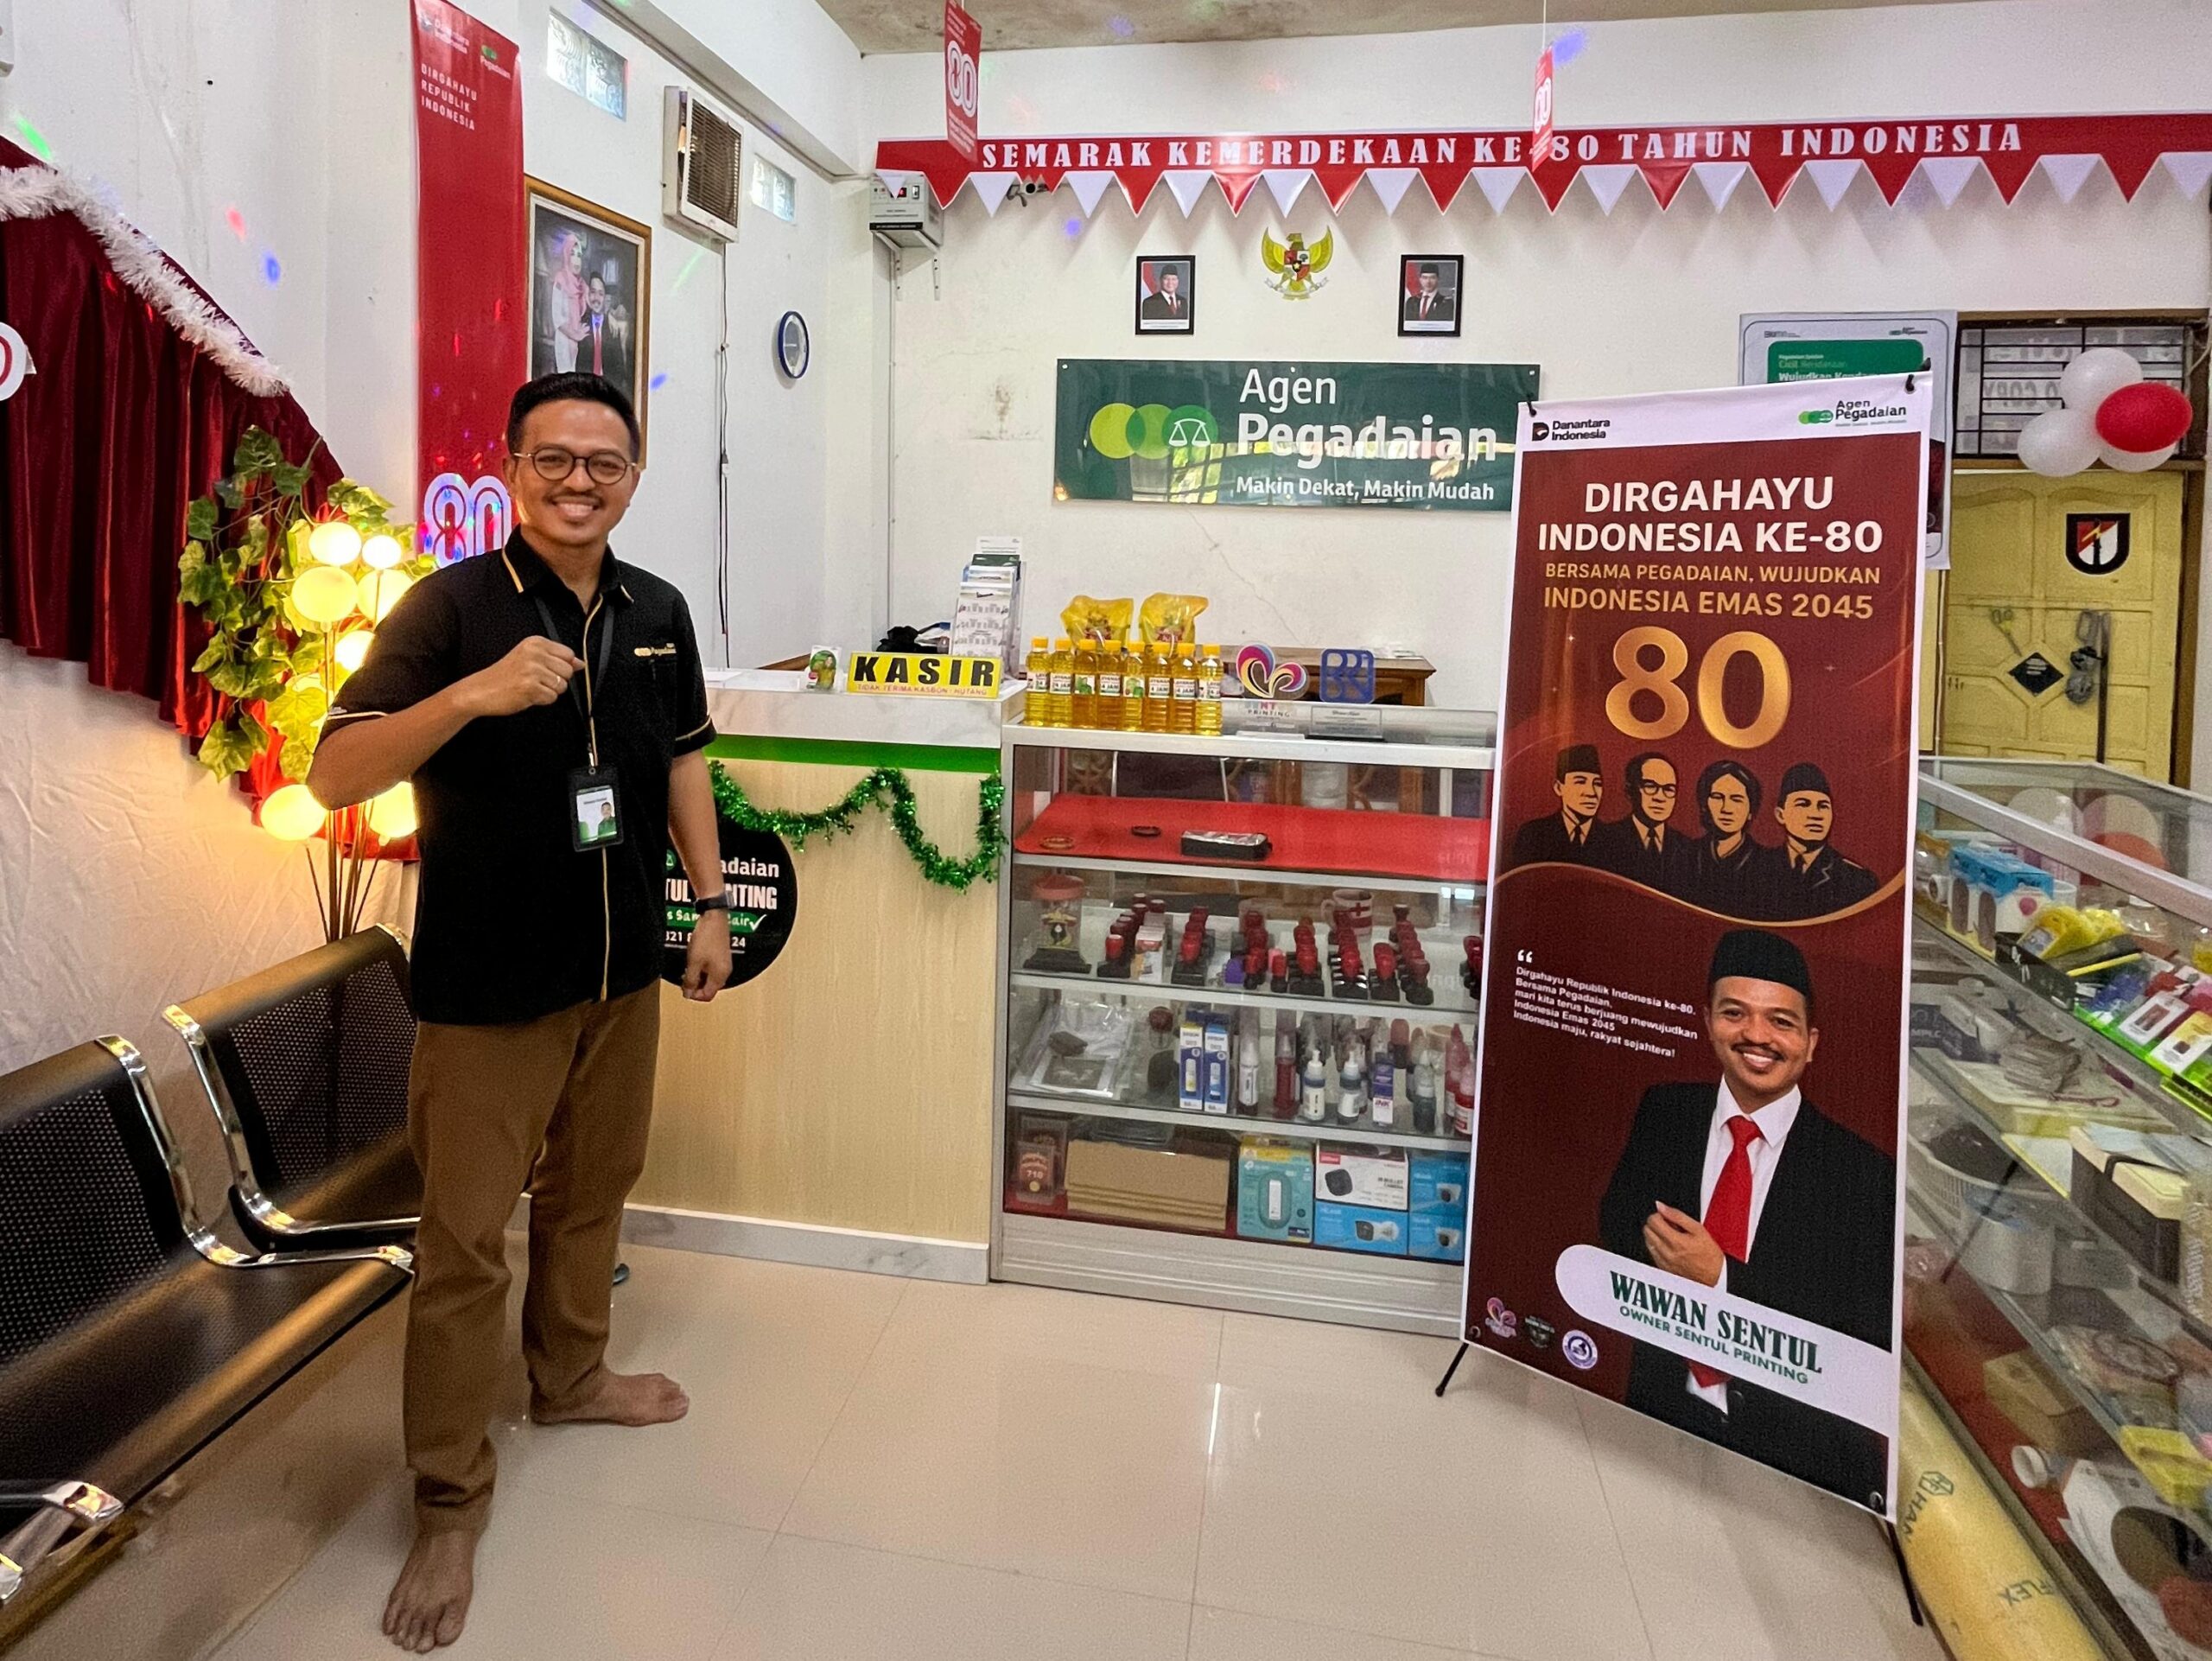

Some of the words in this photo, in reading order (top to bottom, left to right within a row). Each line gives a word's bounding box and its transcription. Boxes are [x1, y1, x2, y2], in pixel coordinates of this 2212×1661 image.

[421, 63, 477, 101] DIRGAHAYU
[421, 79, 470, 112] REPUBLIK
[947, 41, 977, 118] 80
[421, 95, 475, 130] INDONESIA
[982, 142, 1152, 169] SEMARAK
[1168, 138, 1457, 167] KEMERDEKAAN
[1618, 130, 1752, 160] TAHUN
[1781, 124, 2022, 156] INDONESIA
[1239, 367, 1337, 414] Agen
[1836, 400, 1871, 410] Agen
[1552, 418, 1611, 431] Danantara
[1835, 406, 1907, 422] Pegadaian
[1236, 413, 1497, 469] Pegadaian
[1552, 430, 1606, 442] Indonesia
[1236, 476, 1294, 496] Makin
[1299, 478, 1359, 500] Dekat,
[1363, 479, 1424, 499] Makin
[1427, 481, 1495, 500] Mudah
[1585, 476, 1834, 513] DIRGAHAYU
[1538, 522, 1744, 552] INDONESIA
[1755, 520, 1884, 553] KE-80
[1545, 563, 1631, 580] BERSAMA
[1636, 564, 1755, 583] PEGADAIAN,
[1758, 565, 1881, 585] WUJUDKAN
[1544, 587, 1690, 614] INDONESIA
[1698, 591, 1783, 617] EMAS
[1791, 593, 1873, 620] 2045
[854, 656, 995, 687] KASIR
[1605, 626, 1792, 749] 80
[1248, 710, 1290, 718] PRINTING
[1516, 966, 1564, 985] Dirgahayu
[1567, 977, 1610, 996] Republik
[1611, 988, 1662, 1007] Indonesia
[1664, 999, 1697, 1015] ke-80.
[1516, 977, 1557, 995] Bersama
[1559, 989, 1613, 1009] Pegadaian,
[1514, 1000, 1560, 1017] Indonesia
[1562, 1009, 1589, 1025] Emas
[1592, 1019, 1615, 1032] 2045
[1515, 990, 1535, 1001] mari
[1537, 993, 1555, 1006] kita
[1557, 998, 1582, 1013] terus
[1584, 1004, 1629, 1025] berjuang
[1630, 1016, 1699, 1040] mewujudkan
[1513, 1010, 1559, 1029] Indonesia
[1560, 1022, 1588, 1037] maju,
[1590, 1029, 1622, 1046] rakyat
[1624, 1038, 1675, 1058] sejahtera!
[1610, 1270, 1707, 1333] WAWAN
[1717, 1308, 1822, 1373] SENTUL
[1619, 1305, 1671, 1333] OWNER
[1675, 1323, 1731, 1356] SENTUL
[1733, 1349, 1809, 1384] PRINTING
